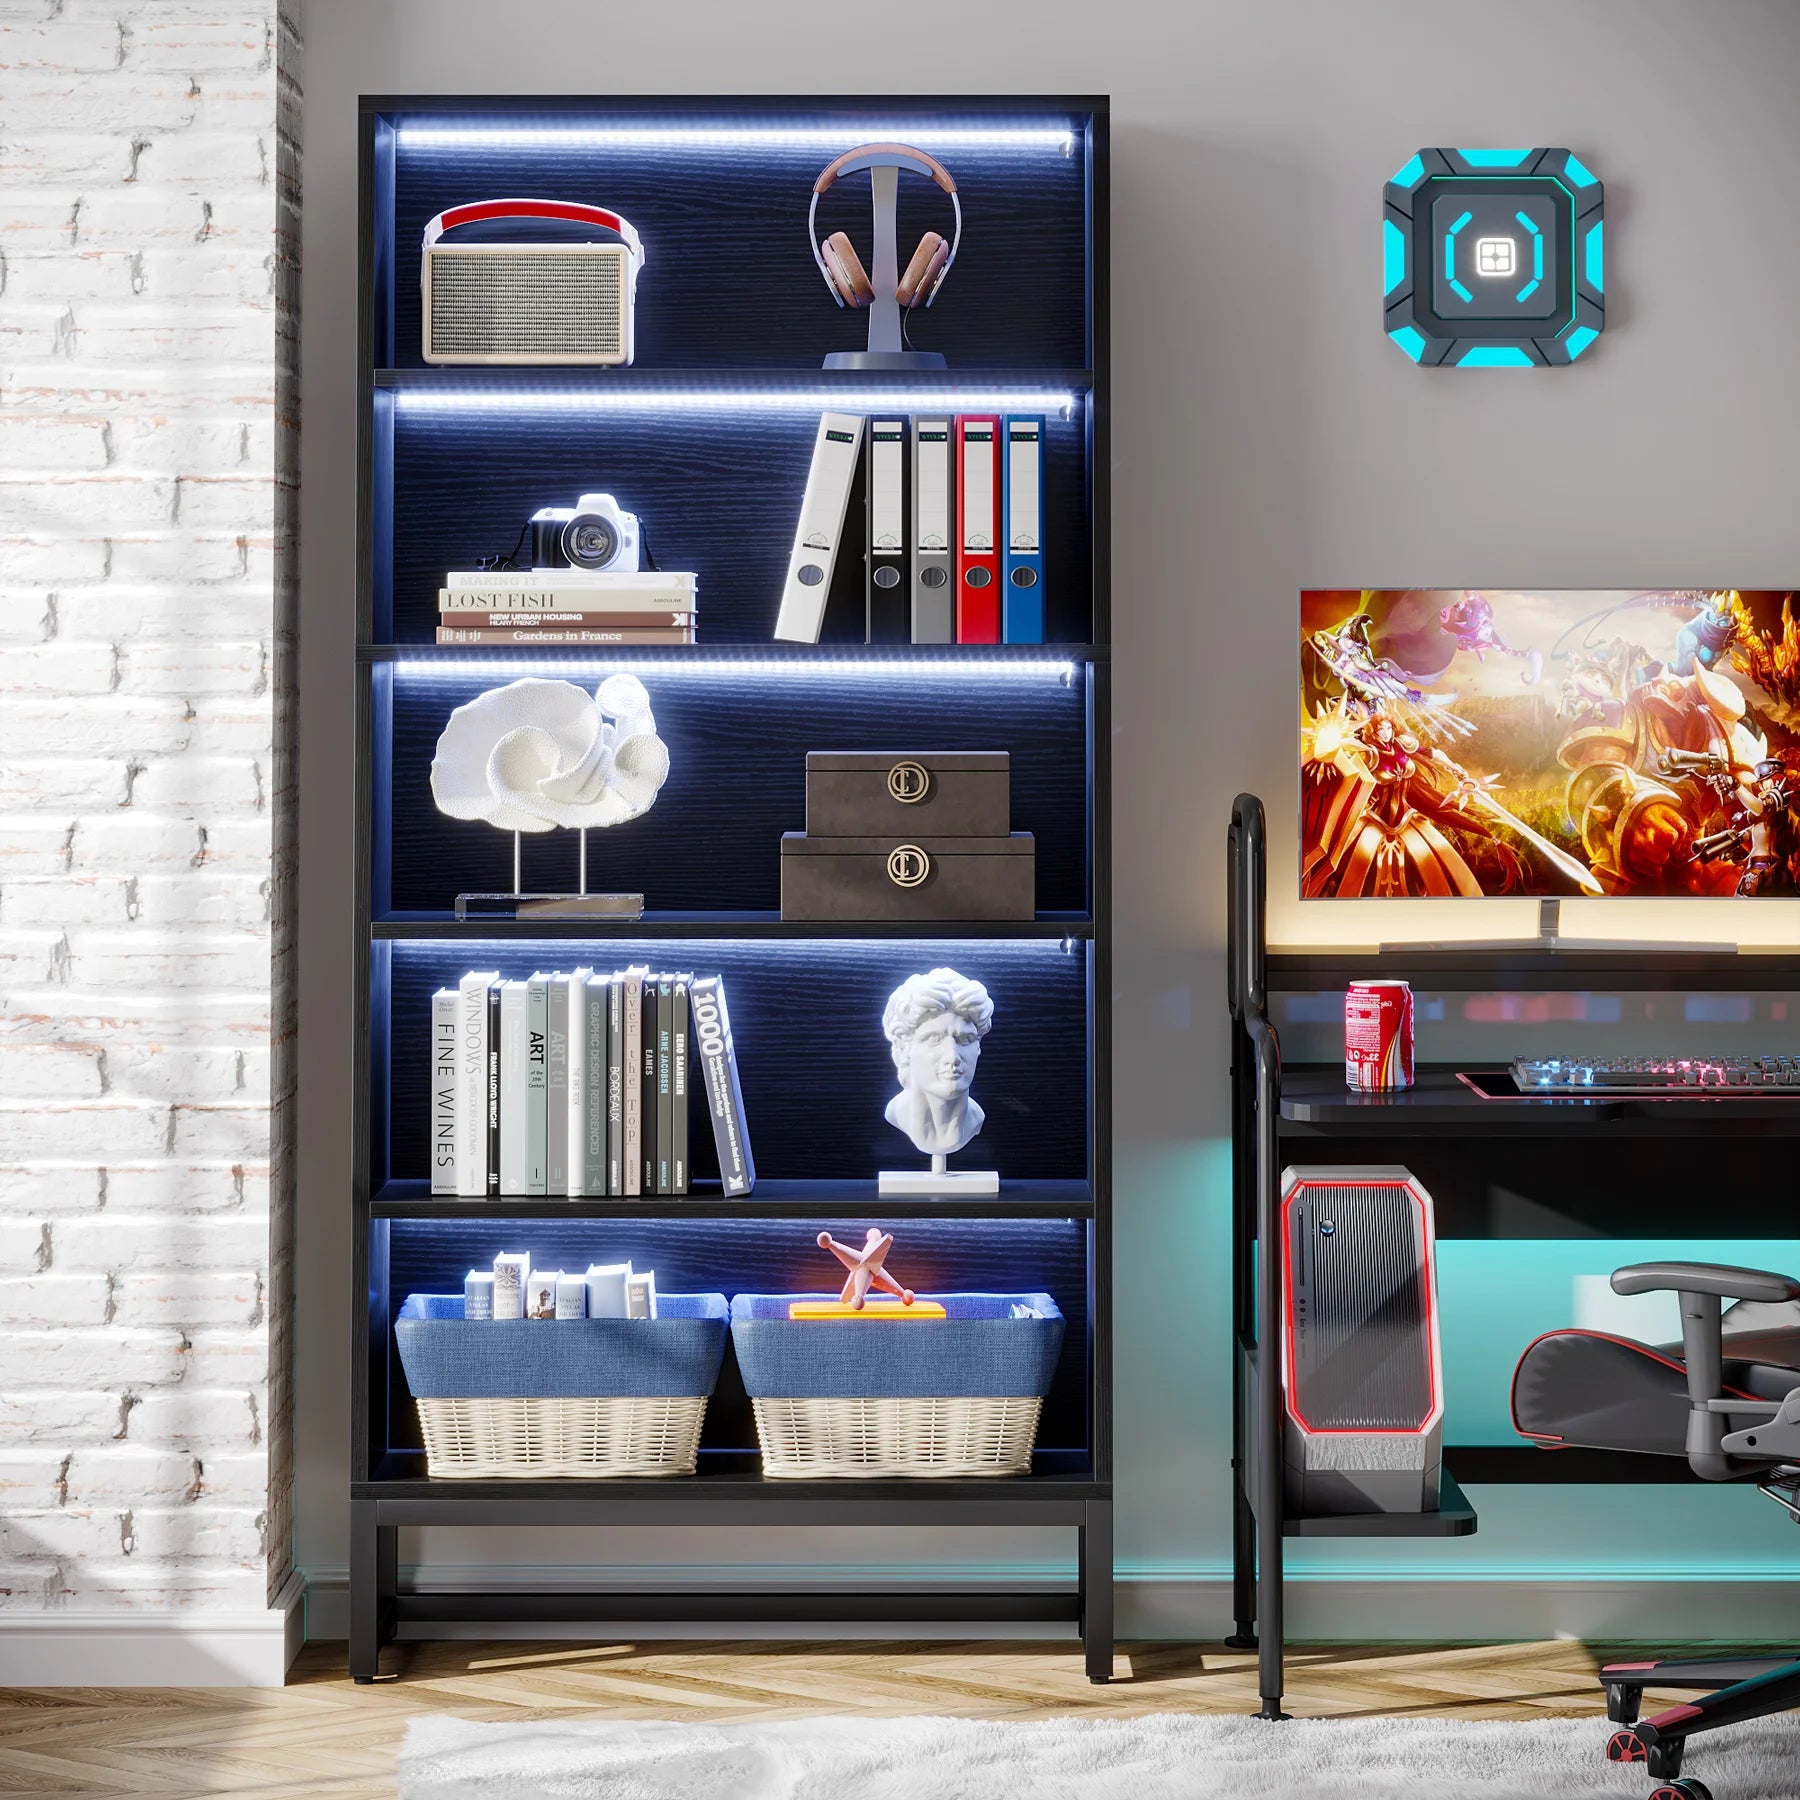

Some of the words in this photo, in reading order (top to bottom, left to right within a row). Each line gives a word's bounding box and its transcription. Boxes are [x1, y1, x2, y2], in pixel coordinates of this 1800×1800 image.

[461, 577, 519, 586] MAKING
[525, 577, 538, 586] IT
[448, 594, 502, 608] LOST
[509, 594, 554, 608] FISH
[513, 631, 563, 640] Gardens
[566, 631, 578, 640] in
[581, 631, 622, 640] France
[465, 988, 482, 1074] WINDOWS
[590, 1002, 600, 1047] GRAPHIC
[693, 993, 724, 1056] 1000
[438, 1024, 455, 1076] FINE
[530, 1031, 544, 1064] ART
[551, 1031, 566, 1064] ART
[660, 1031, 669, 1052] ARNE
[676, 1033, 685, 1054] EERO
[490, 1052, 498, 1075] FRANK
[590, 1050, 600, 1086] DESIGN
[645, 1049, 653, 1076] EAMES
[660, 1054, 669, 1094] JACOBSEN
[676, 1056, 685, 1095] SAARINEN
[469, 1084, 478, 1118] BERGDORF
[490, 1076, 498, 1099] LLOYD
[610, 1066, 620, 1122] BORDEAUX
[720, 1084, 728, 1093] the
[490, 1100, 498, 1129] WRIGHT
[590, 1089, 600, 1155] REFERENCED
[716, 1100, 724, 1117] Rudge
[726, 1114, 734, 1124] and
[438, 1088, 455, 1168] WINES
[469, 1120, 478, 1156] GOODMAN
[728, 1124, 736, 1141] where
[731, 1146, 740, 1158] find
[733, 1158, 741, 1172] them
